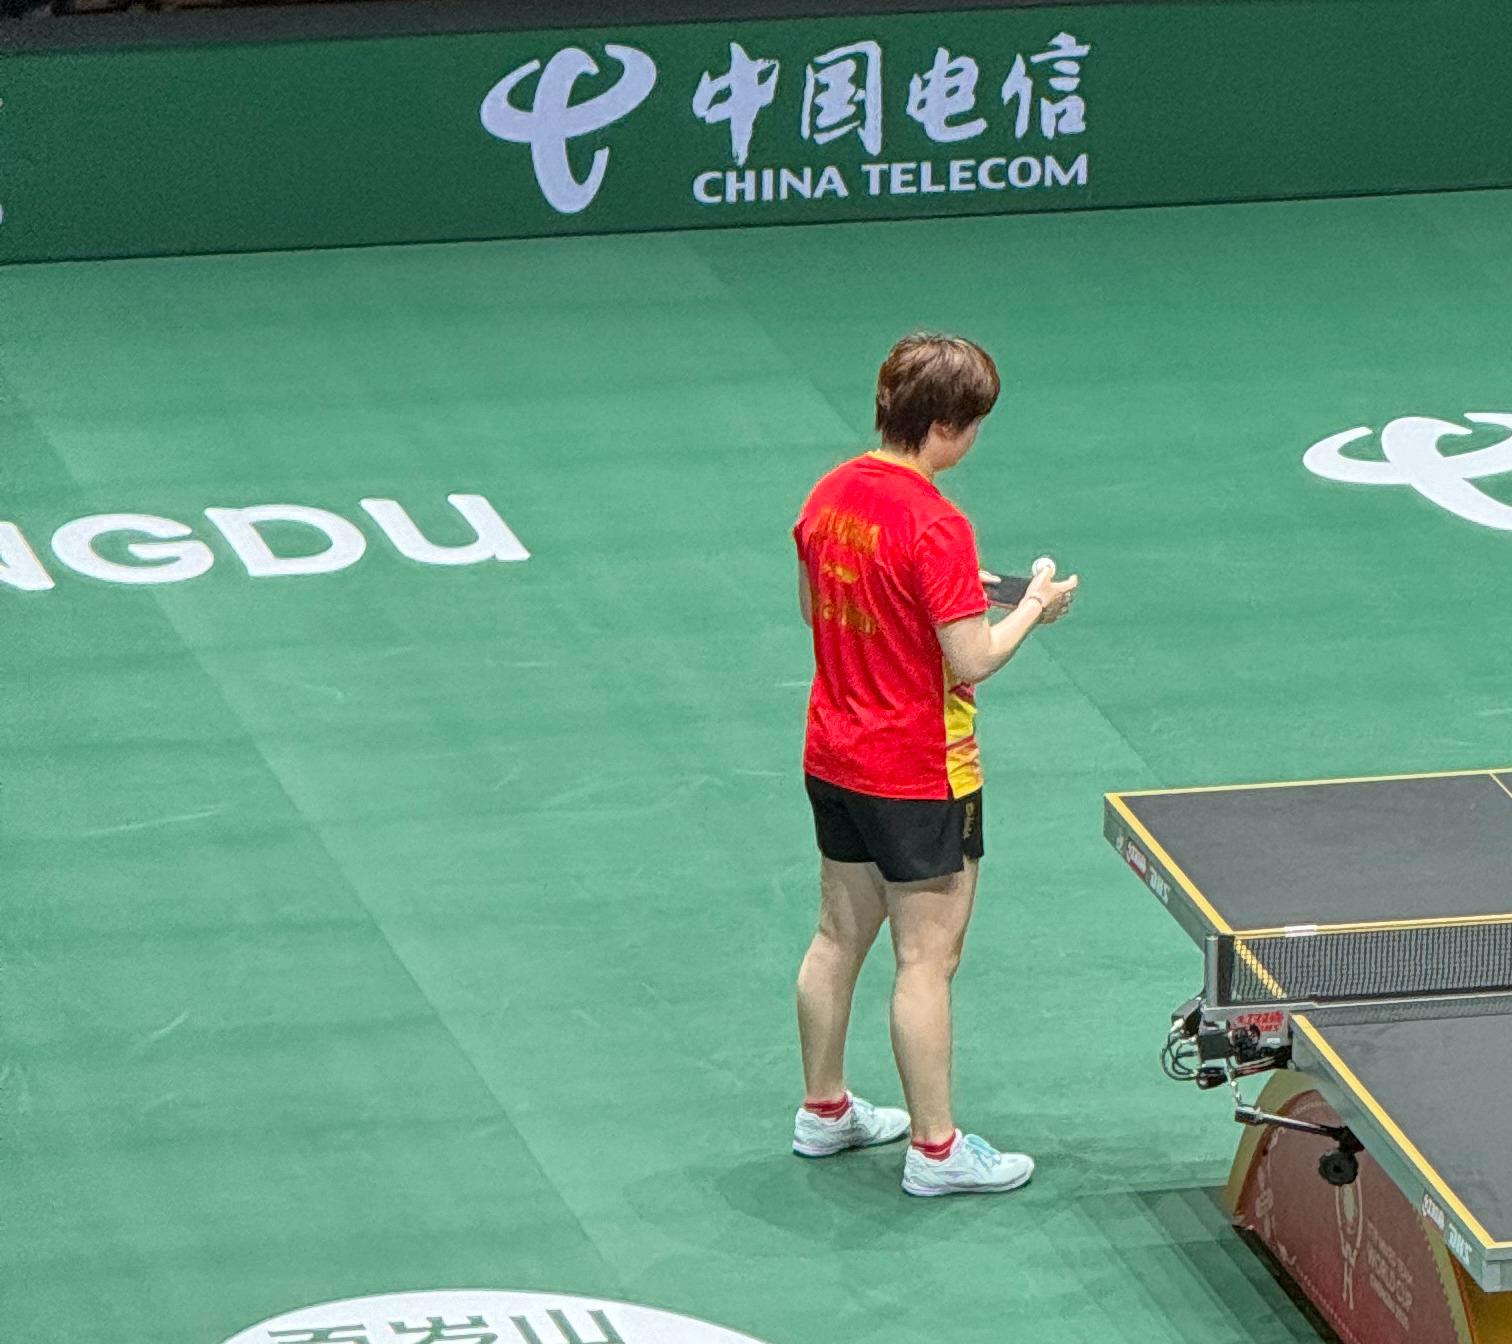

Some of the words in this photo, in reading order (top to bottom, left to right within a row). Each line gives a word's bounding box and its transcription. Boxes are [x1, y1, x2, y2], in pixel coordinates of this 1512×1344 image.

[692, 31, 1092, 167] 中国电信
[692, 165, 848, 205] CHINA
[860, 153, 1090, 195] TELECOM
